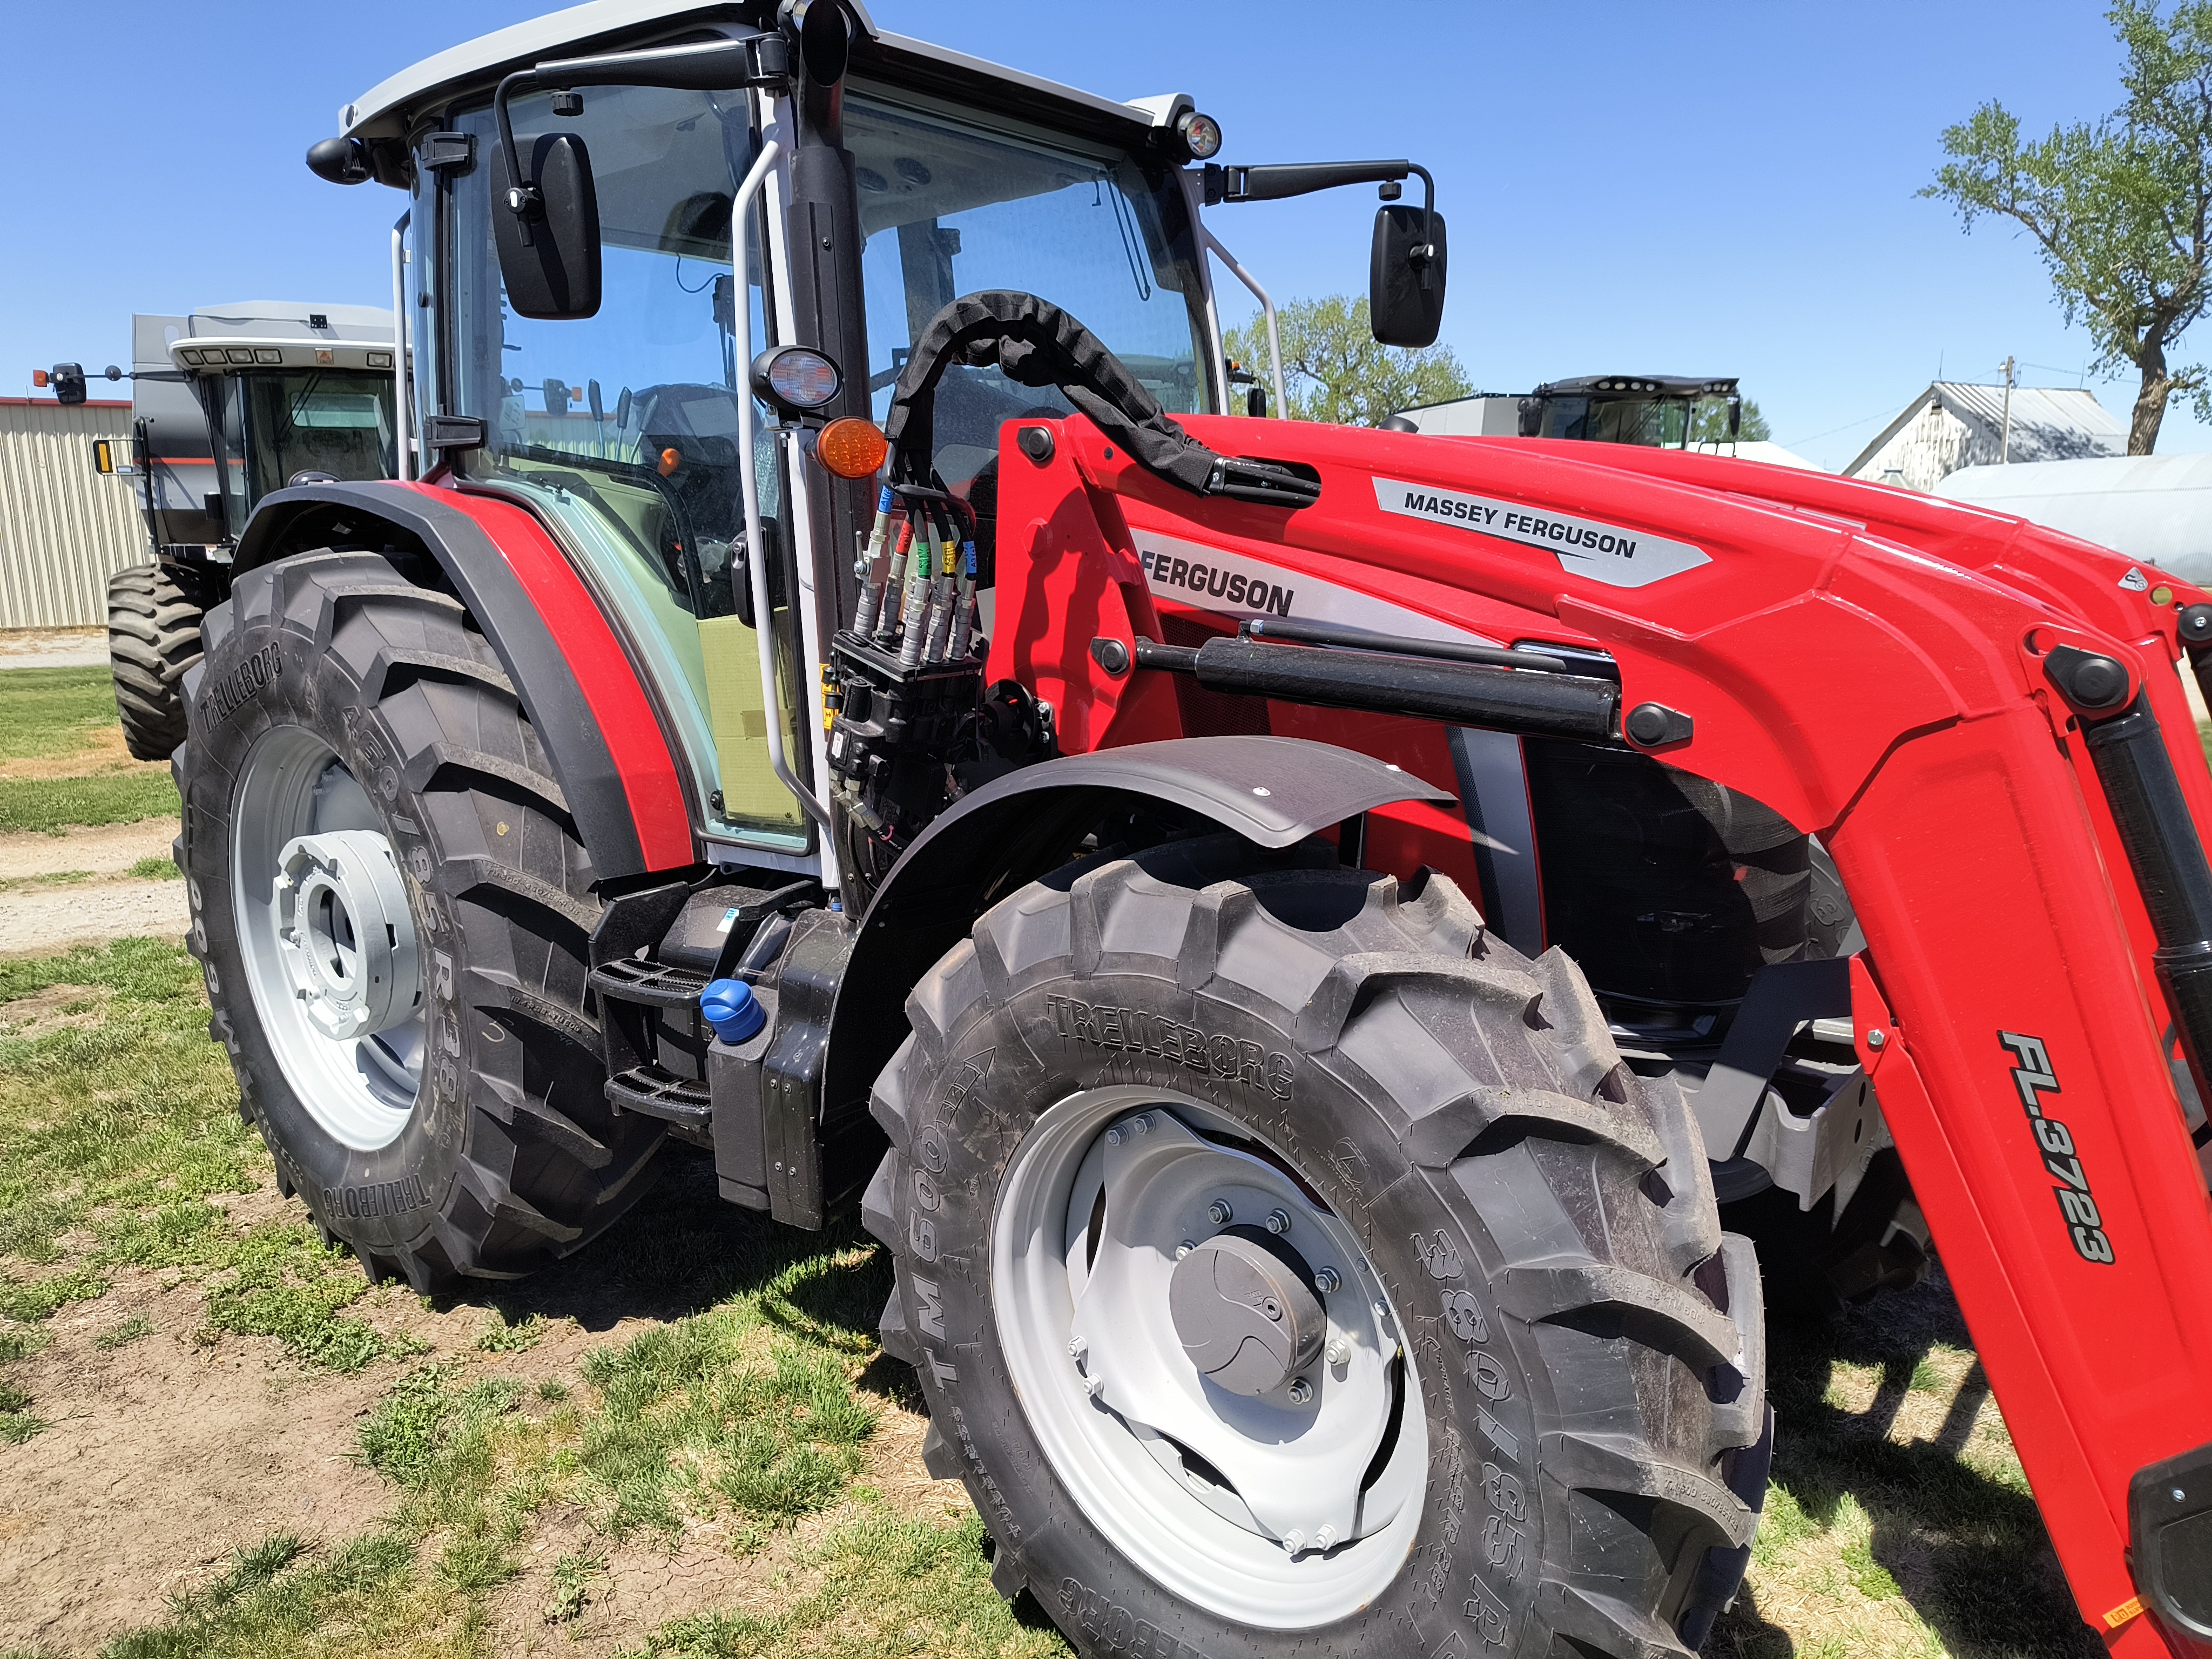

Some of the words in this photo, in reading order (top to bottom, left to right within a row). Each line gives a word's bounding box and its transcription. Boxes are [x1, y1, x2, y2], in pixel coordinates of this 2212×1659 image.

[1404, 492, 1498, 525] MASSEY
[1503, 511, 1637, 559] FERGUSON
[1141, 550, 1294, 618] FERGUSON
[200, 639, 284, 734] TRELLEBORG
[1046, 992, 1298, 1102] TRELLEBORG
[1997, 1029, 2115, 1265] FL.3723
[323, 1172, 434, 1220] TRELLEBORG
